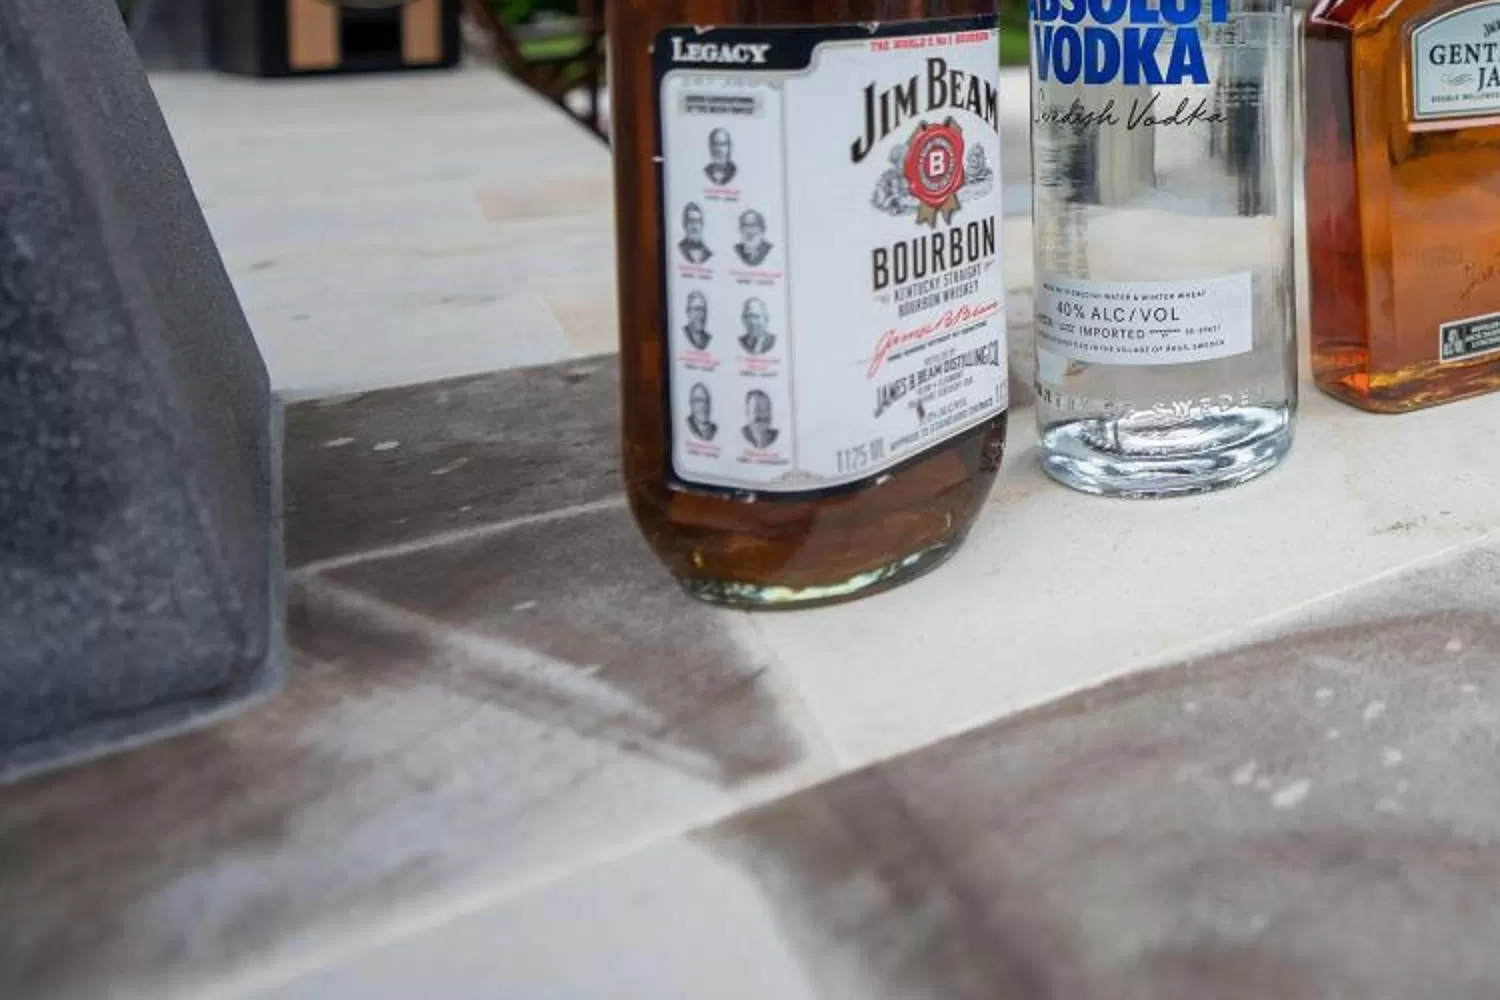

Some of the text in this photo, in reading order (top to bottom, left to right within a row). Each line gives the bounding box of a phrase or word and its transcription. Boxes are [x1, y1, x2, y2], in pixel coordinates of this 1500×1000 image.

[671, 36, 771, 64] LEGACY
[1034, 25, 1210, 85] VODKA
[850, 79, 918, 164] JIM
[927, 57, 999, 136] BEAM
[1126, 91, 1229, 131] Vodka
[928, 150, 946, 177] B
[872, 215, 995, 292] BOURBON
[1056, 300, 1085, 320] 40%
[1090, 305, 1181, 323] ALC/VOL
[1079, 324, 1145, 340] IMPORTED
